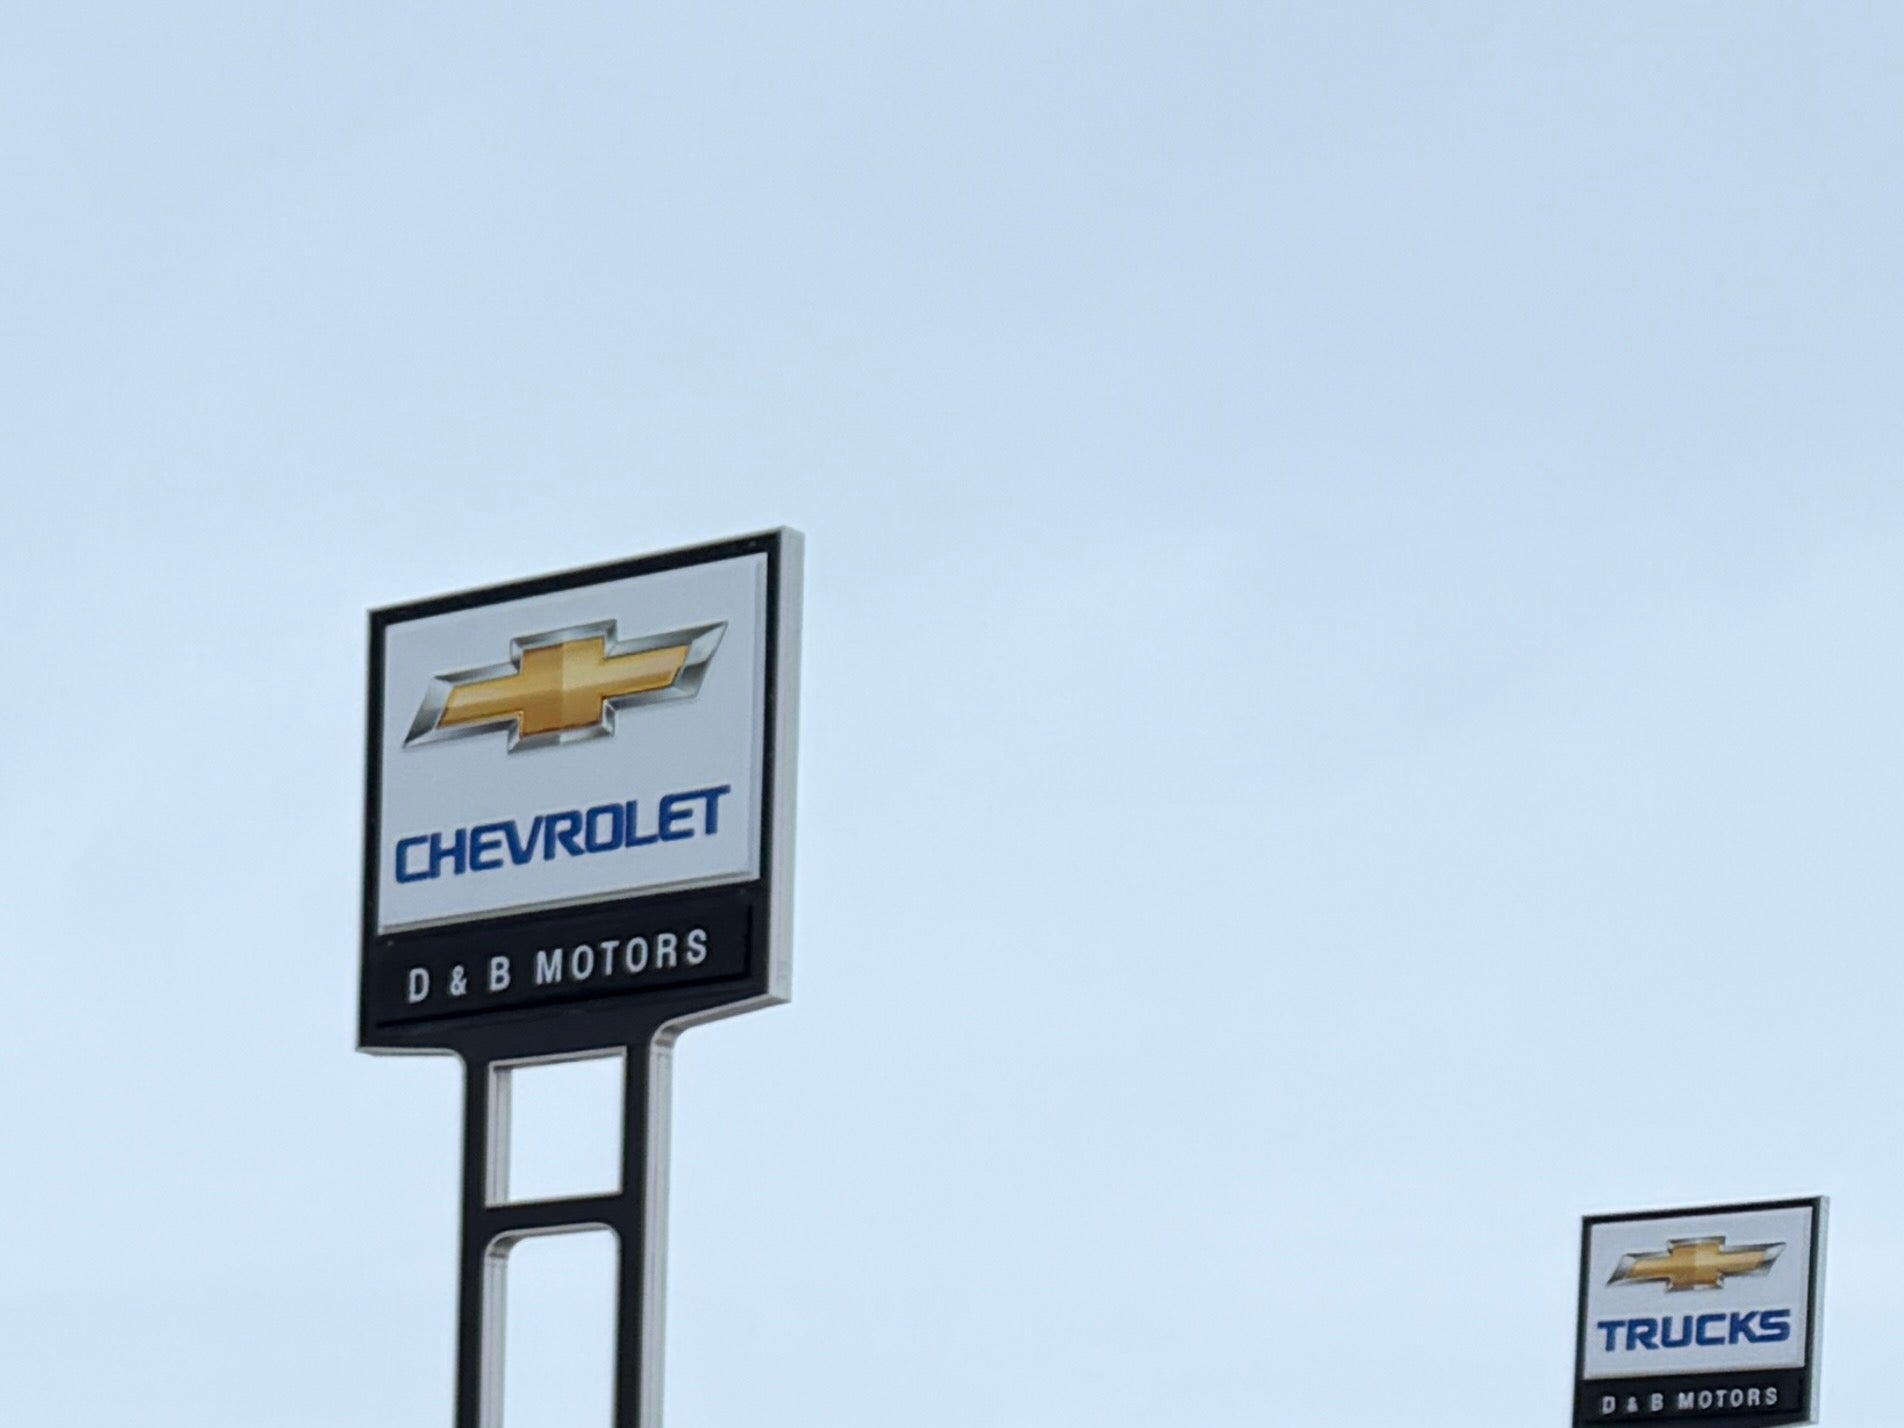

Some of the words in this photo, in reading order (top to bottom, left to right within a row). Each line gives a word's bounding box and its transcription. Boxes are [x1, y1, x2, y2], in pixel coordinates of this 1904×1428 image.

[394, 784, 732, 885] CHEVROLET
[407, 966, 430, 1004] D
[448, 961, 468, 996] &
[488, 954, 512, 992] B
[535, 928, 710, 983] MOTORS
[1596, 1308, 1792, 1353] TRUCKS
[1600, 1396, 1617, 1415] D
[1626, 1395, 1640, 1413] &
[1649, 1392, 1665, 1411] B
[1677, 1386, 1779, 1410] MOTORS
